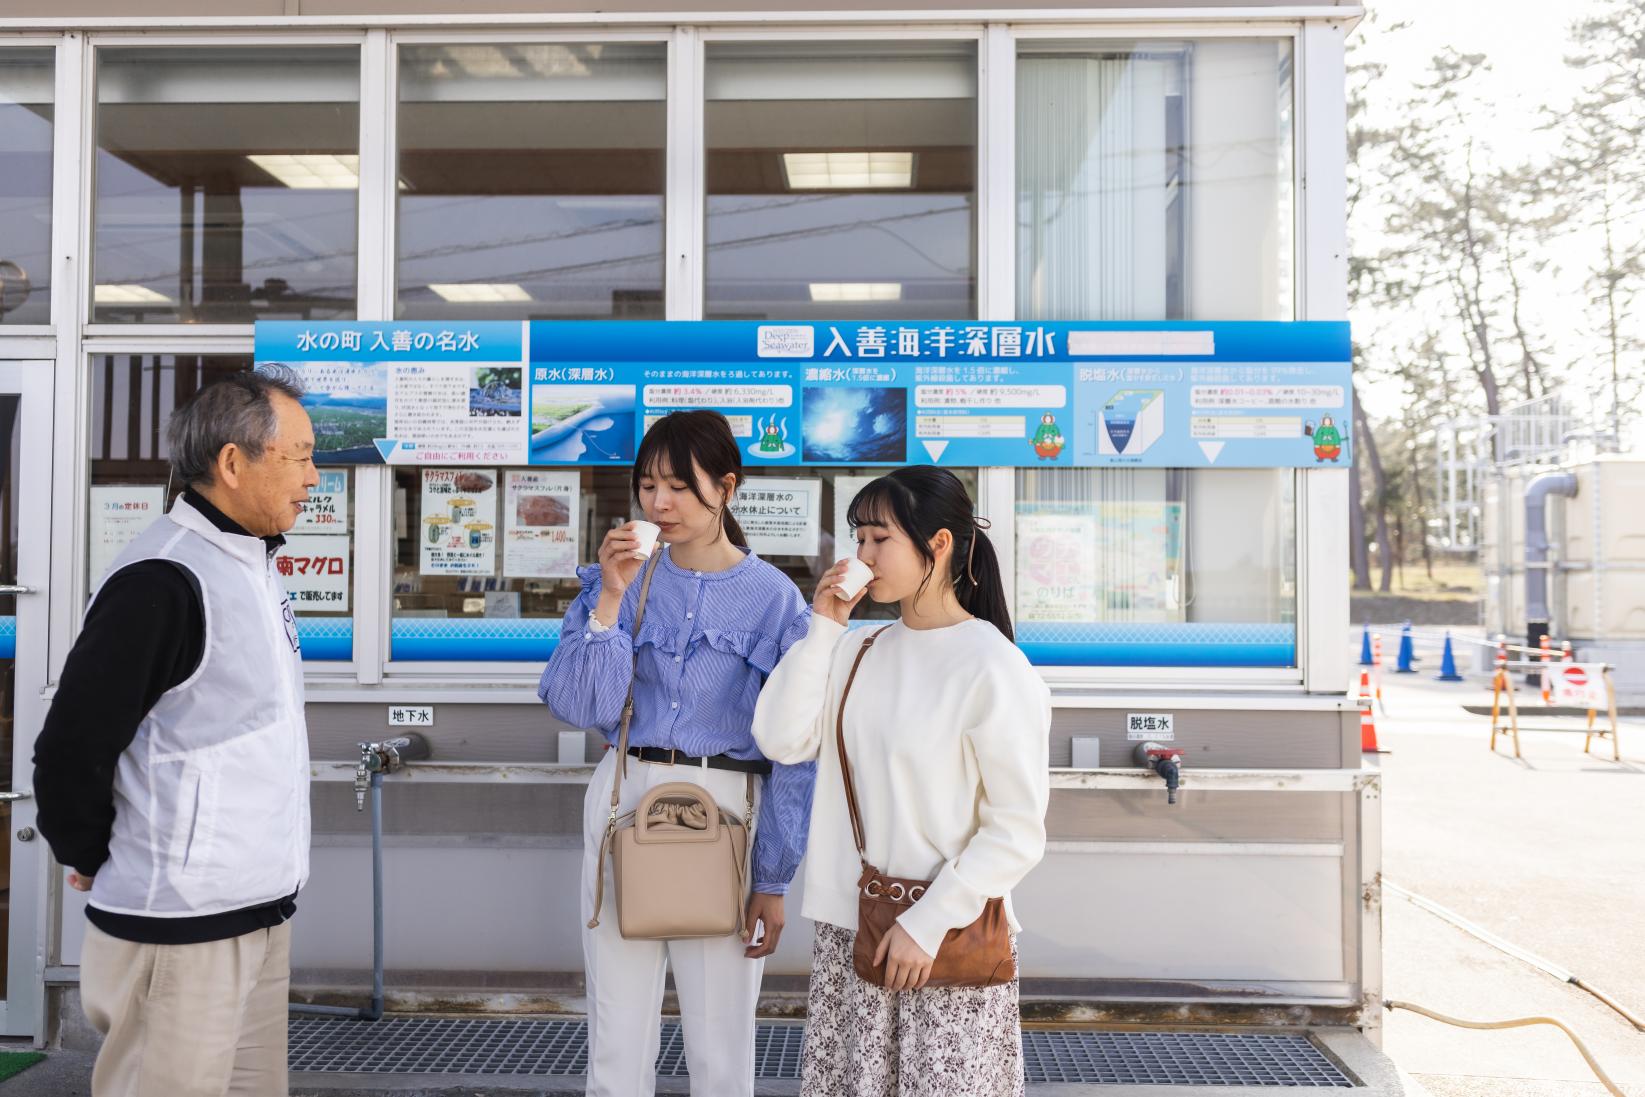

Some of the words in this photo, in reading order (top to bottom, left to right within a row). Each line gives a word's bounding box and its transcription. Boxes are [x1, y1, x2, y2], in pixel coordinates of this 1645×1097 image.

[296, 330, 363, 351] 水の町
[370, 330, 481, 351] 入善の名水
[823, 326, 1056, 358] 入善海洋深層水
[738, 492, 794, 502] 海洋深層水の
[392, 708, 430, 723] 地下水
[1130, 716, 1170, 730] 脱塩水
